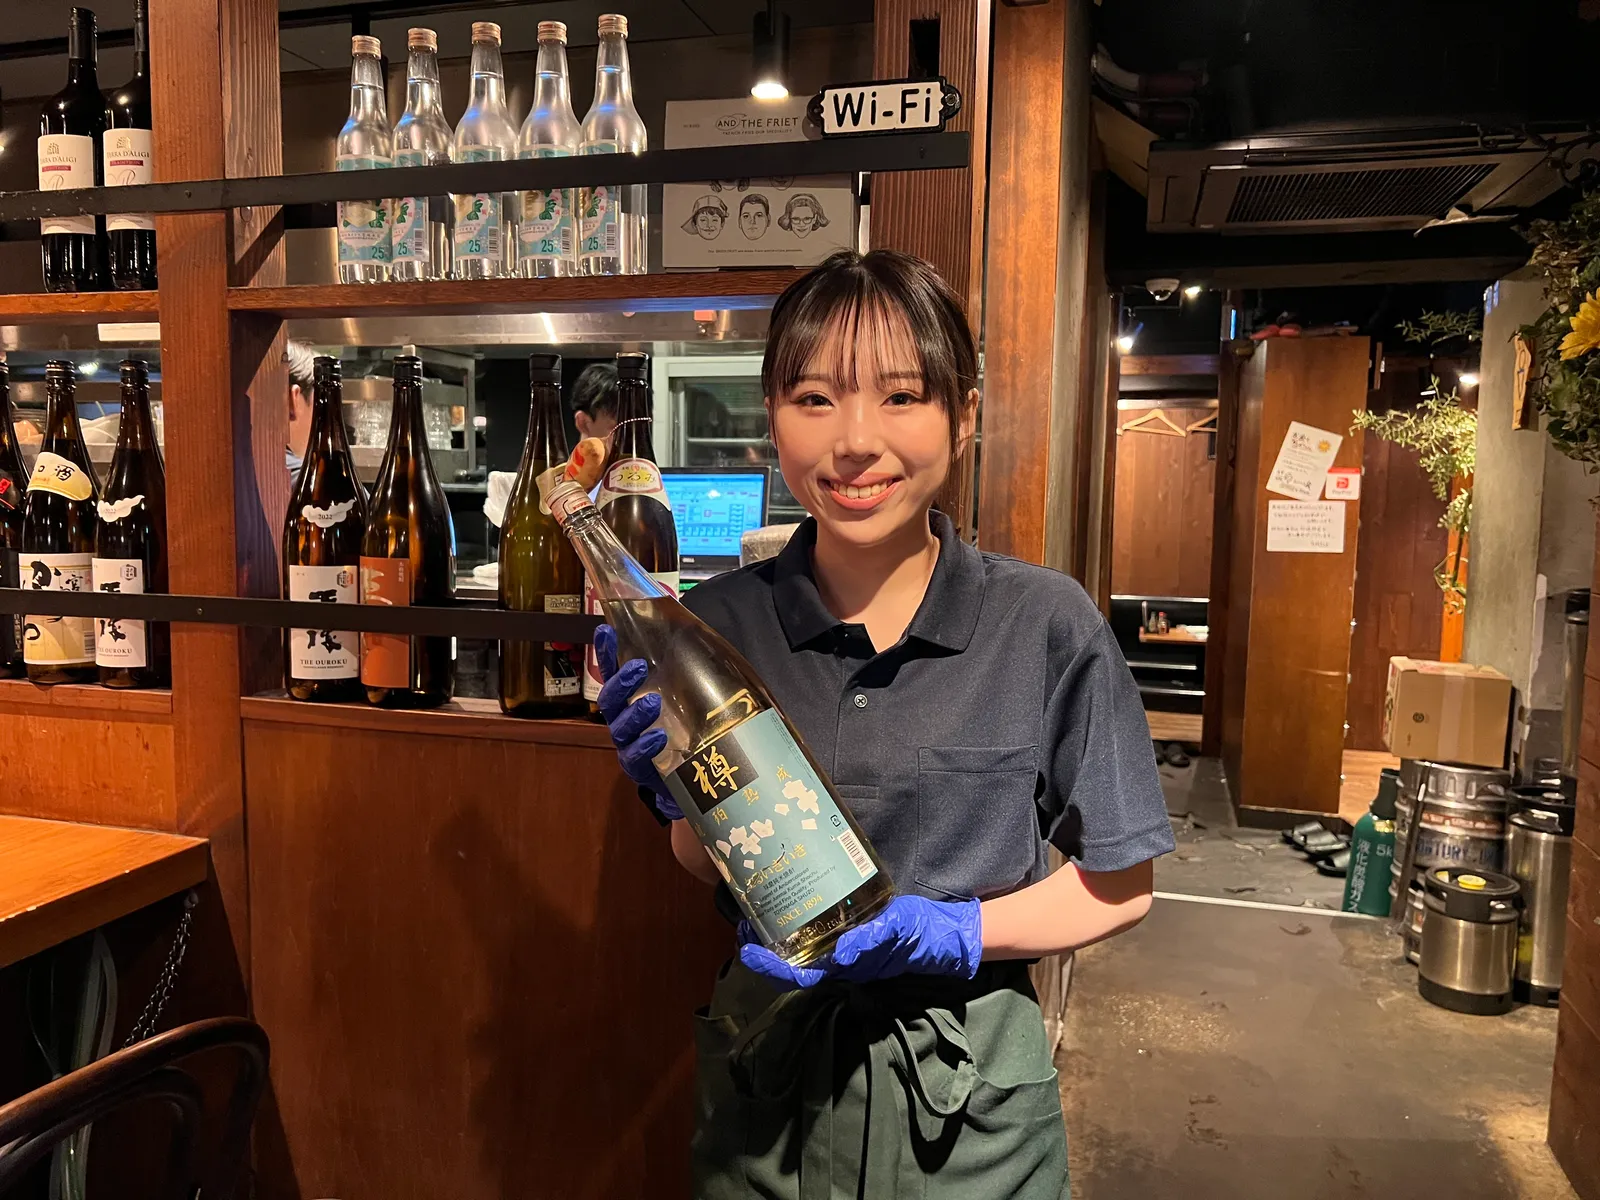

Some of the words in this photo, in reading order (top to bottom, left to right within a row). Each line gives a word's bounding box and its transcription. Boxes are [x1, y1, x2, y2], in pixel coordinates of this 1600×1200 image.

[833, 88, 932, 128] Wi-Fi
[717, 119, 737, 128] AND
[741, 118, 763, 128] THE
[766, 117, 798, 127] FRIET
[397, 242, 408, 255] 25
[468, 239, 481, 253] 25
[541, 239, 554, 253] 25
[588, 237, 599, 251] 25
[371, 246, 385, 259] 25
[691, 745, 739, 799] 樽
[773, 898, 798, 916] TOYONAGA
[797, 887, 815, 901] SHUZO
[776, 906, 803, 927] SINCE
[803, 893, 823, 911] 1894
